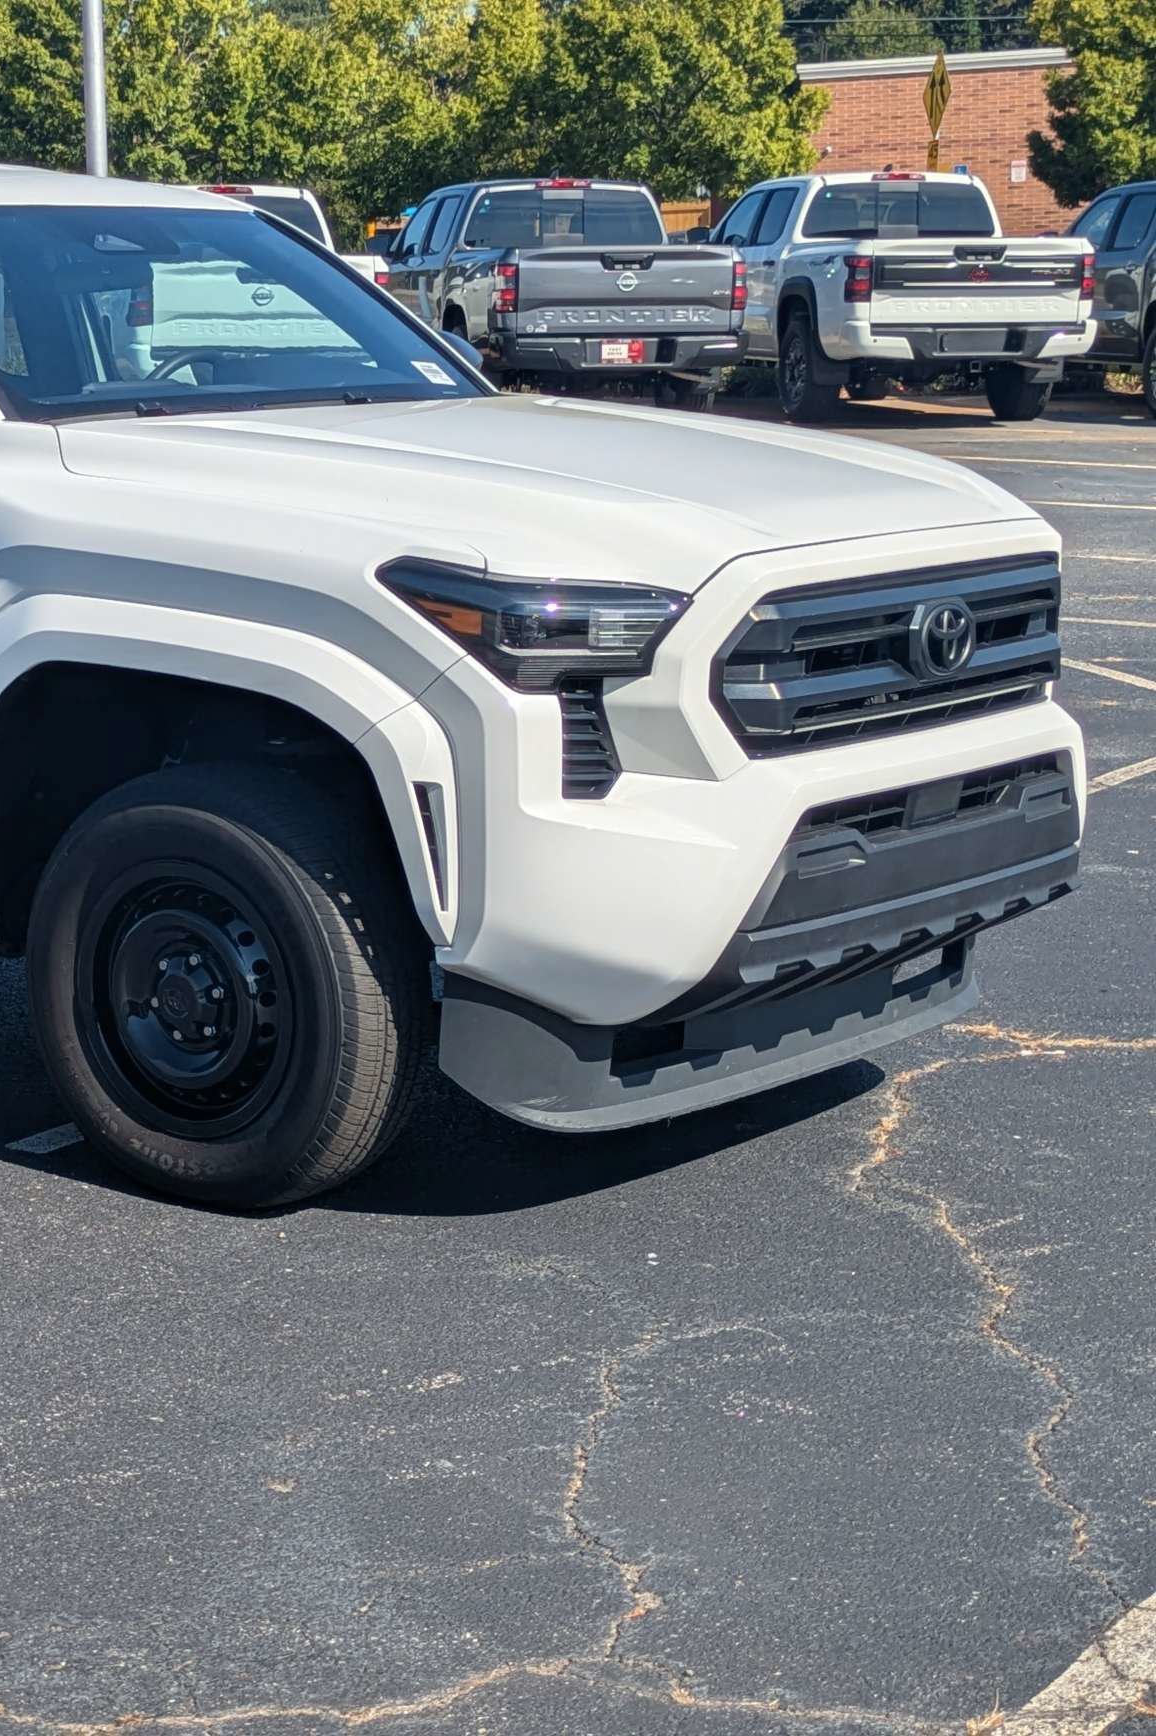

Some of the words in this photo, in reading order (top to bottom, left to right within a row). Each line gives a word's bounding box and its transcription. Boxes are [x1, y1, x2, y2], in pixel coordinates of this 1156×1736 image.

[892, 301, 1061, 313] FRONTIER
[536, 309, 714, 323] FRONTIER
[172, 321, 334, 336] FRONTIE
